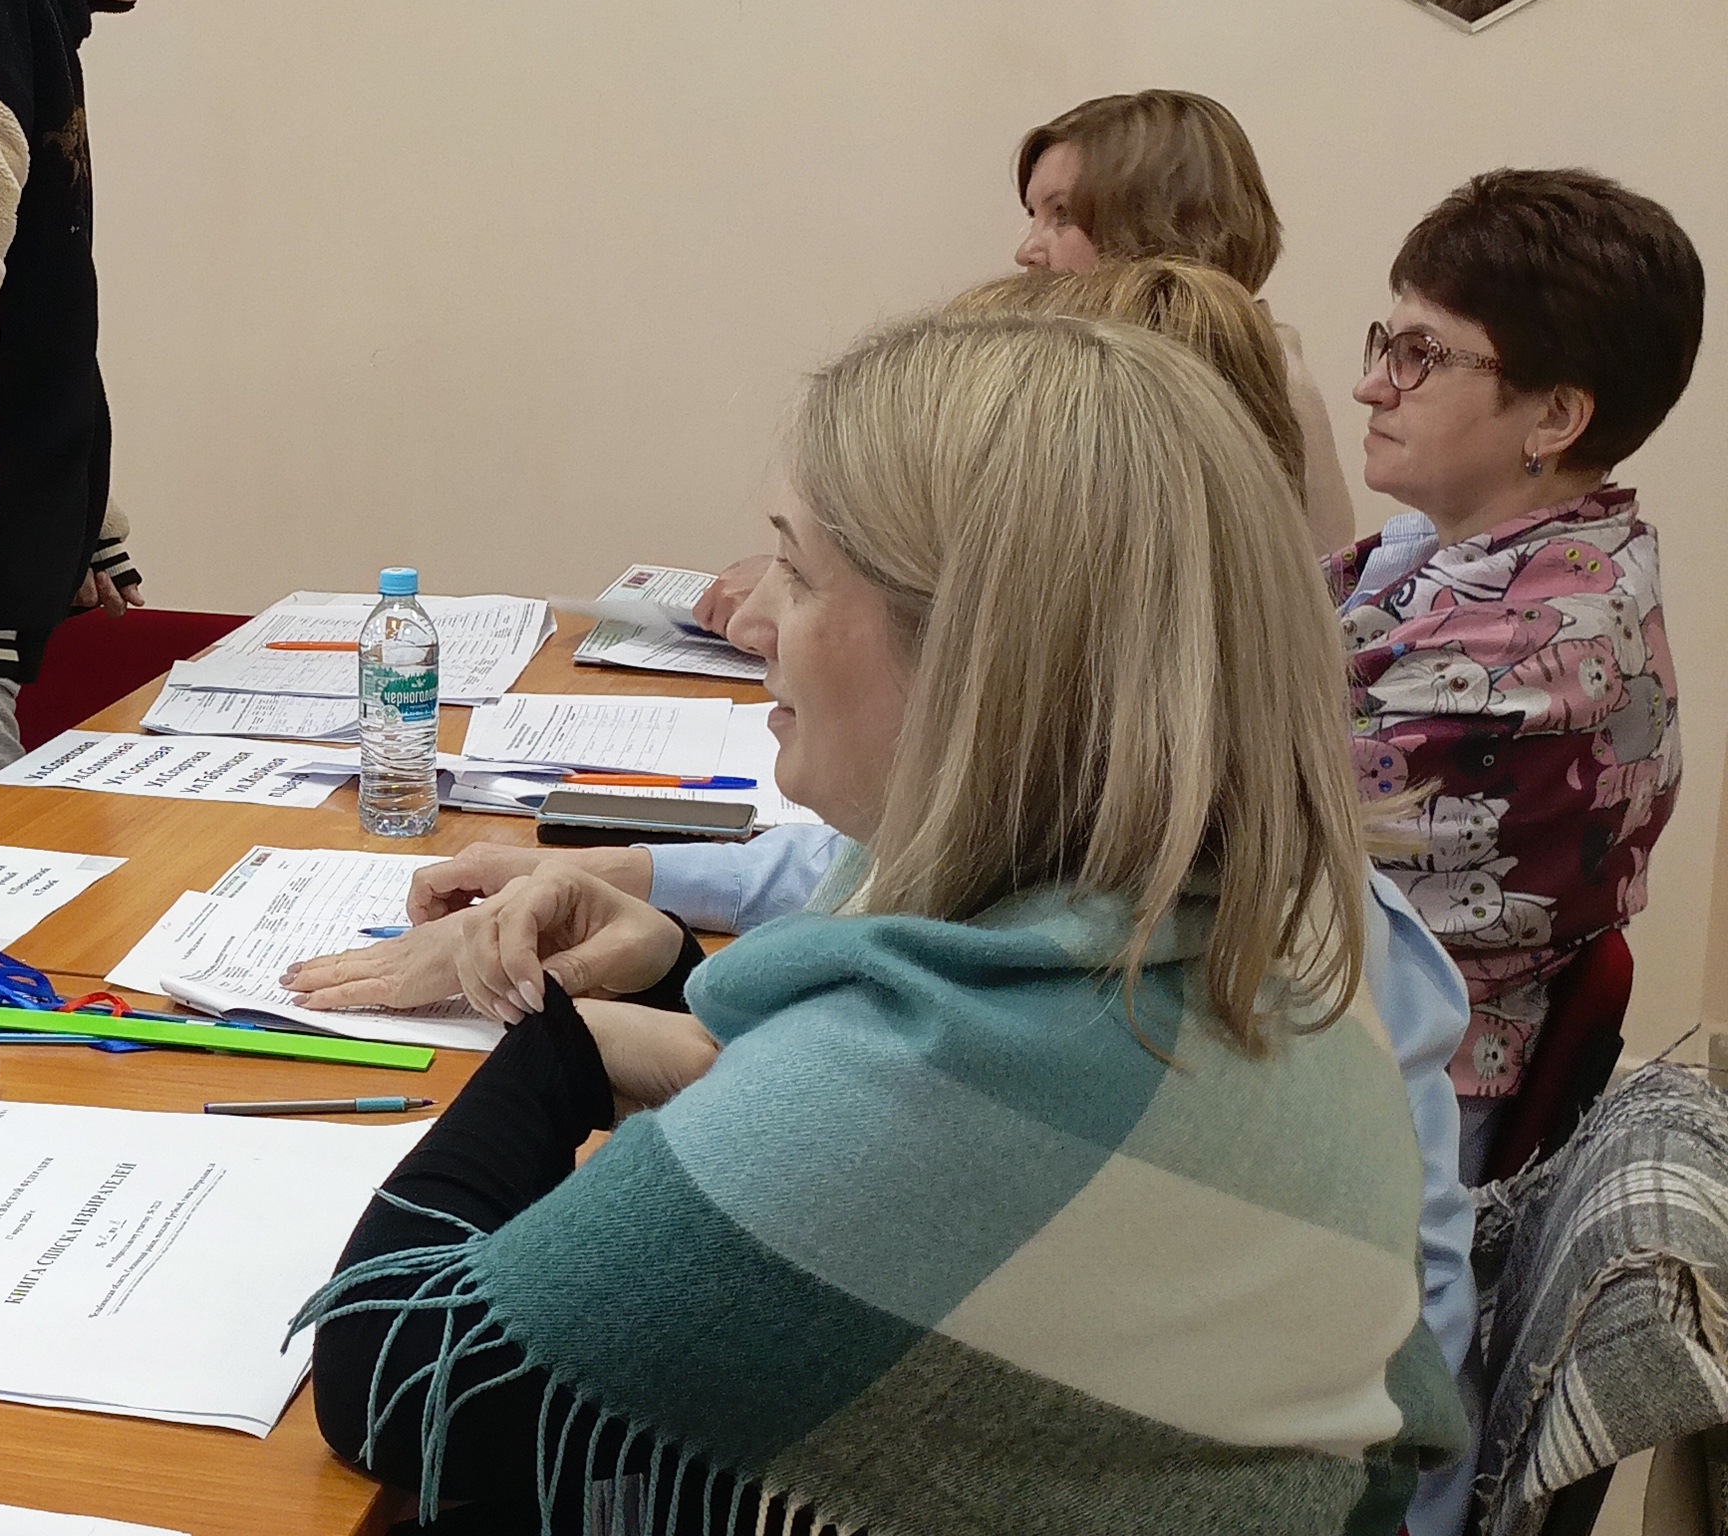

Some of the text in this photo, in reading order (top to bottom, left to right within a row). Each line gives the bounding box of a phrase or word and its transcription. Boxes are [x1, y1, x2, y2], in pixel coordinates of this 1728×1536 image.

[3, 1161, 137, 1304] КНИГА СПИСКА ИЗБИРАТЕЛЕЙ
